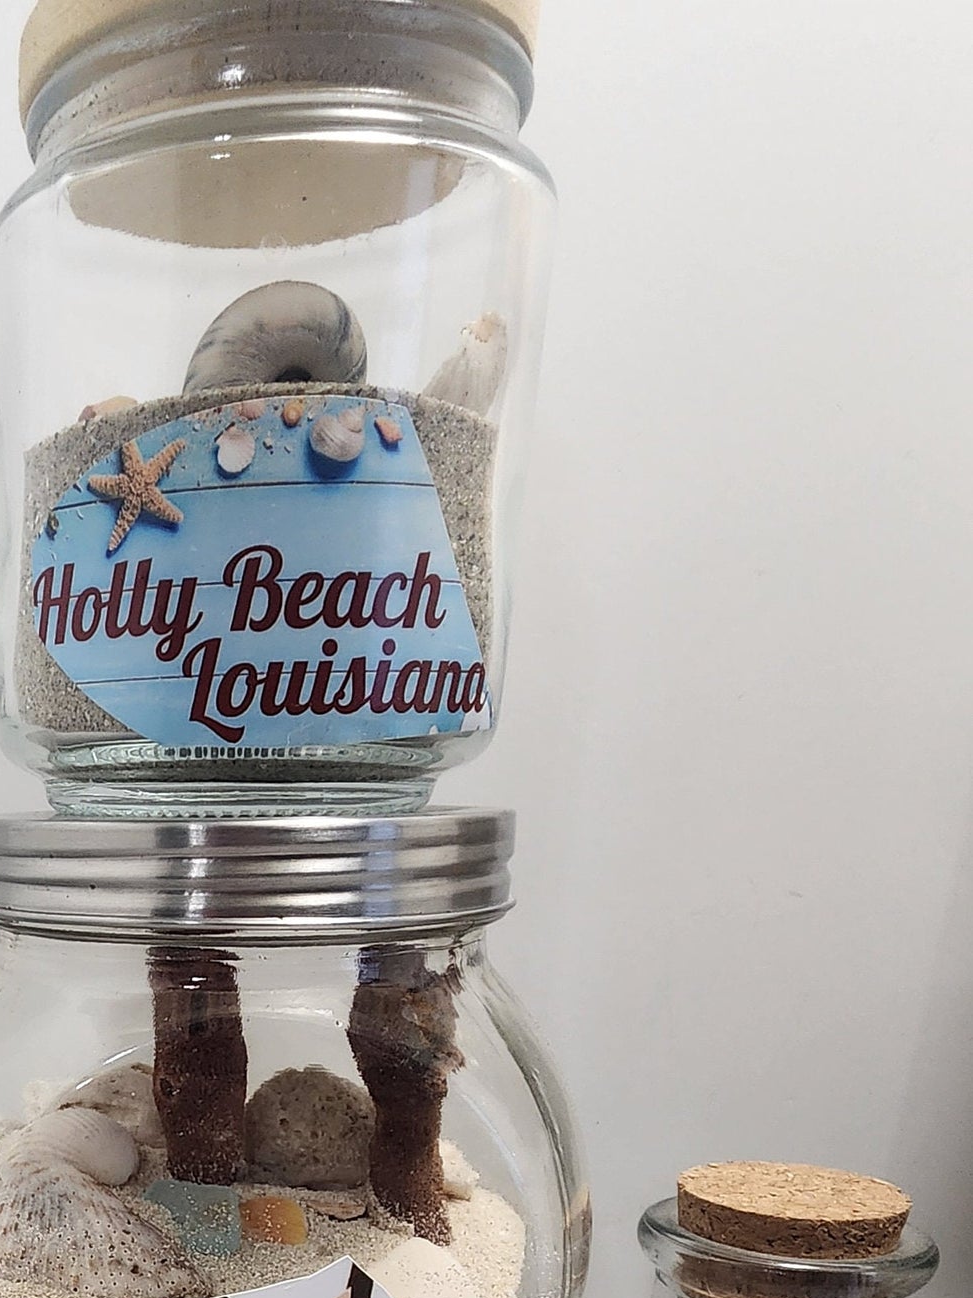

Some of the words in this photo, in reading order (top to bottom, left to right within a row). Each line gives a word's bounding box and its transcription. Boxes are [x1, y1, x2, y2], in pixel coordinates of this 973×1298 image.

[33, 557, 204, 662] Holly
[223, 544, 447, 632] Beach
[182, 638, 488, 743] Louisiana
